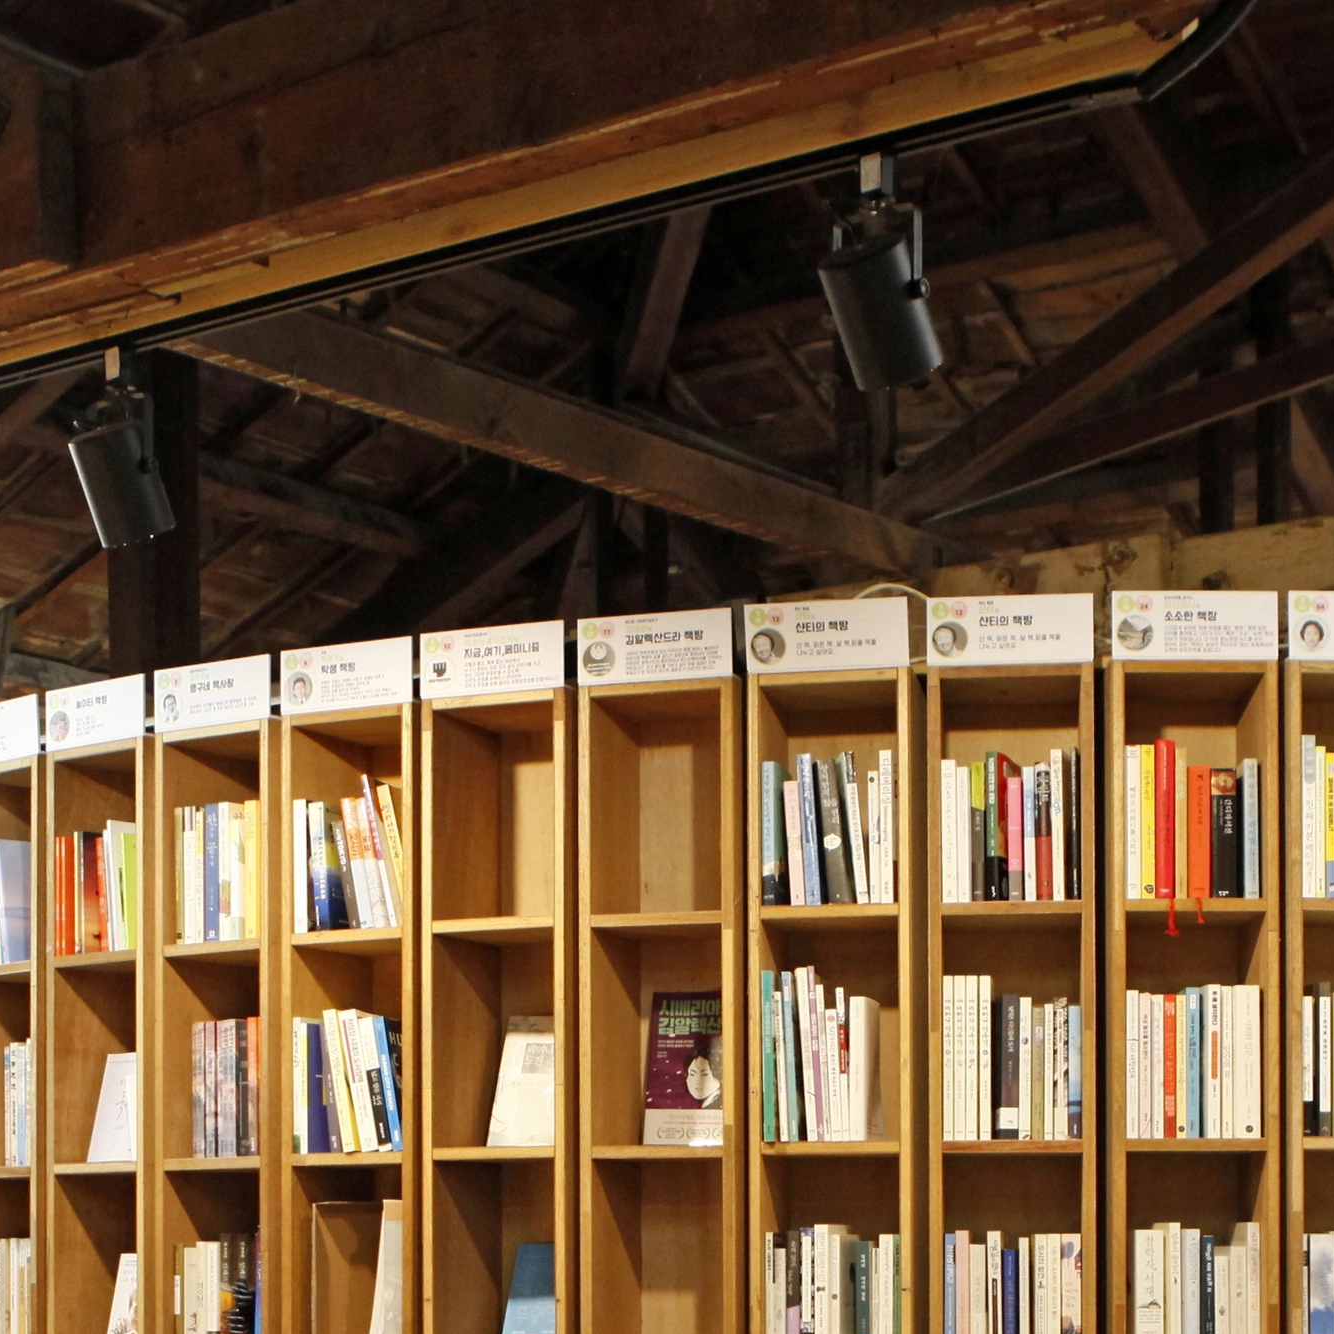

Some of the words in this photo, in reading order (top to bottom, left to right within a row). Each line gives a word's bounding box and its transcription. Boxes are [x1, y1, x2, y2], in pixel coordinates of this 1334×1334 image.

[978, 615, 1009, 628] 샨티의
[1163, 610, 1195, 622] 소소한
[1197, 610, 1218, 621] 책장
[795, 620, 825, 635] 샨티의
[624, 630, 682, 646] 김알렉산드라
[336, 840, 347, 865] TOKYO
[386, 1091, 395, 1111] DESIGN
